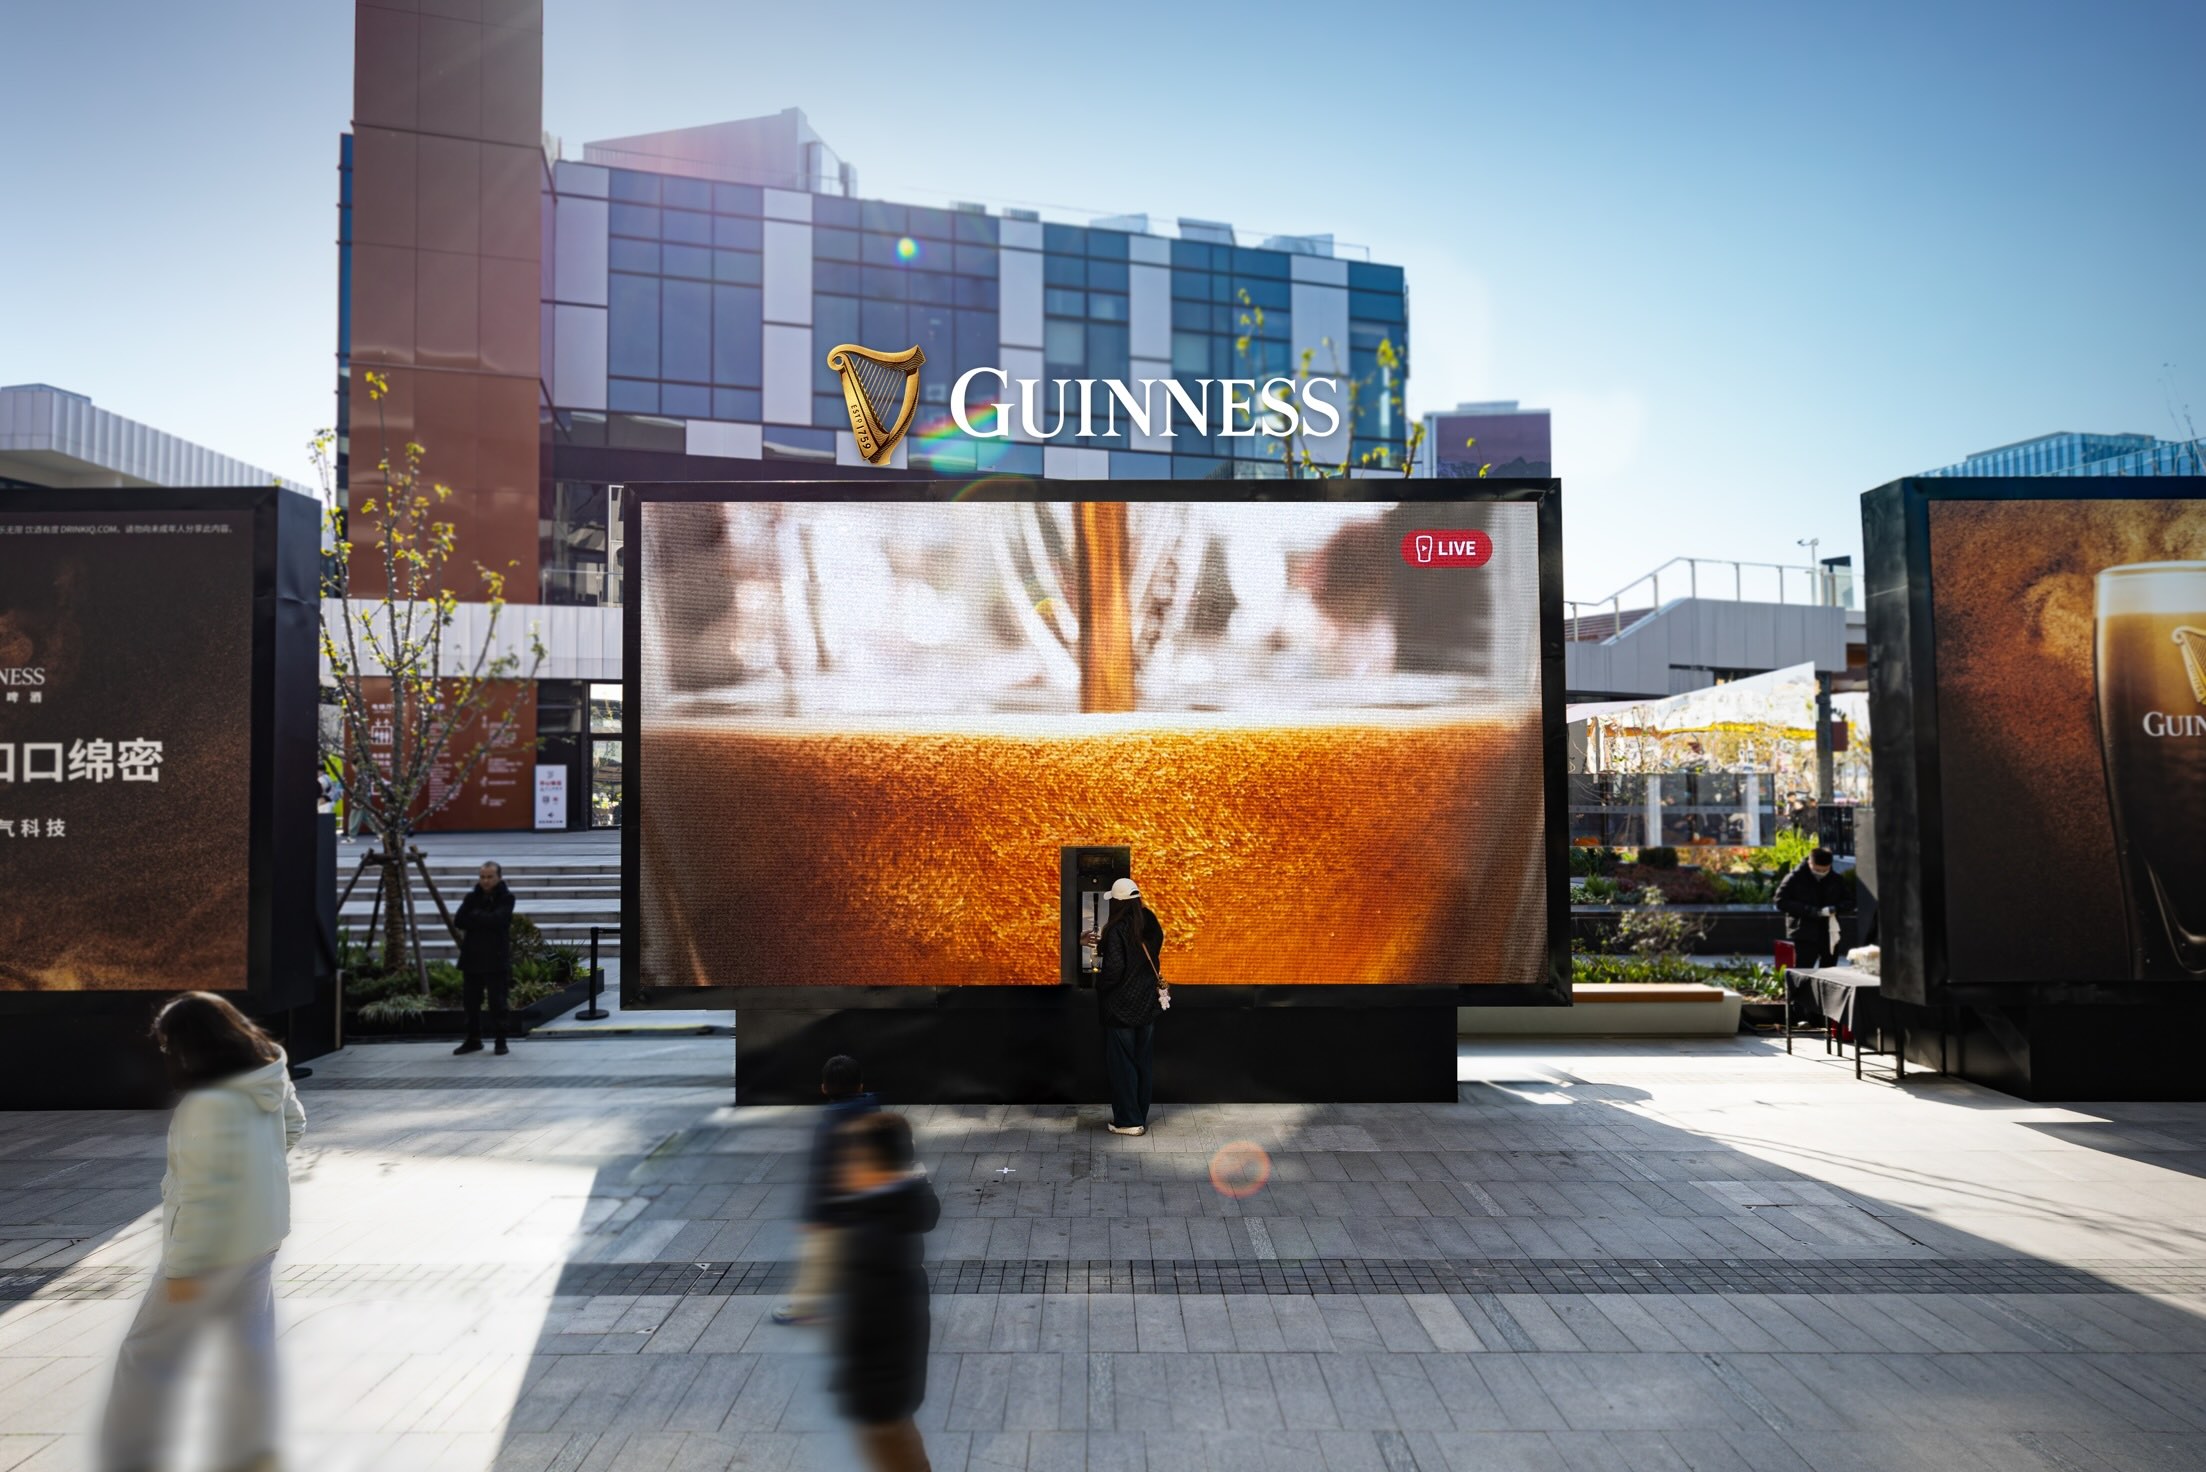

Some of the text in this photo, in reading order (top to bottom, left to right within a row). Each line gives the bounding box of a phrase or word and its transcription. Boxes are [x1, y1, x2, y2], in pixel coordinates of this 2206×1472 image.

[950, 367, 1340, 438] GUINNESS
[856, 425, 872, 449] 1759
[1438, 541, 1476, 556] LIVE
